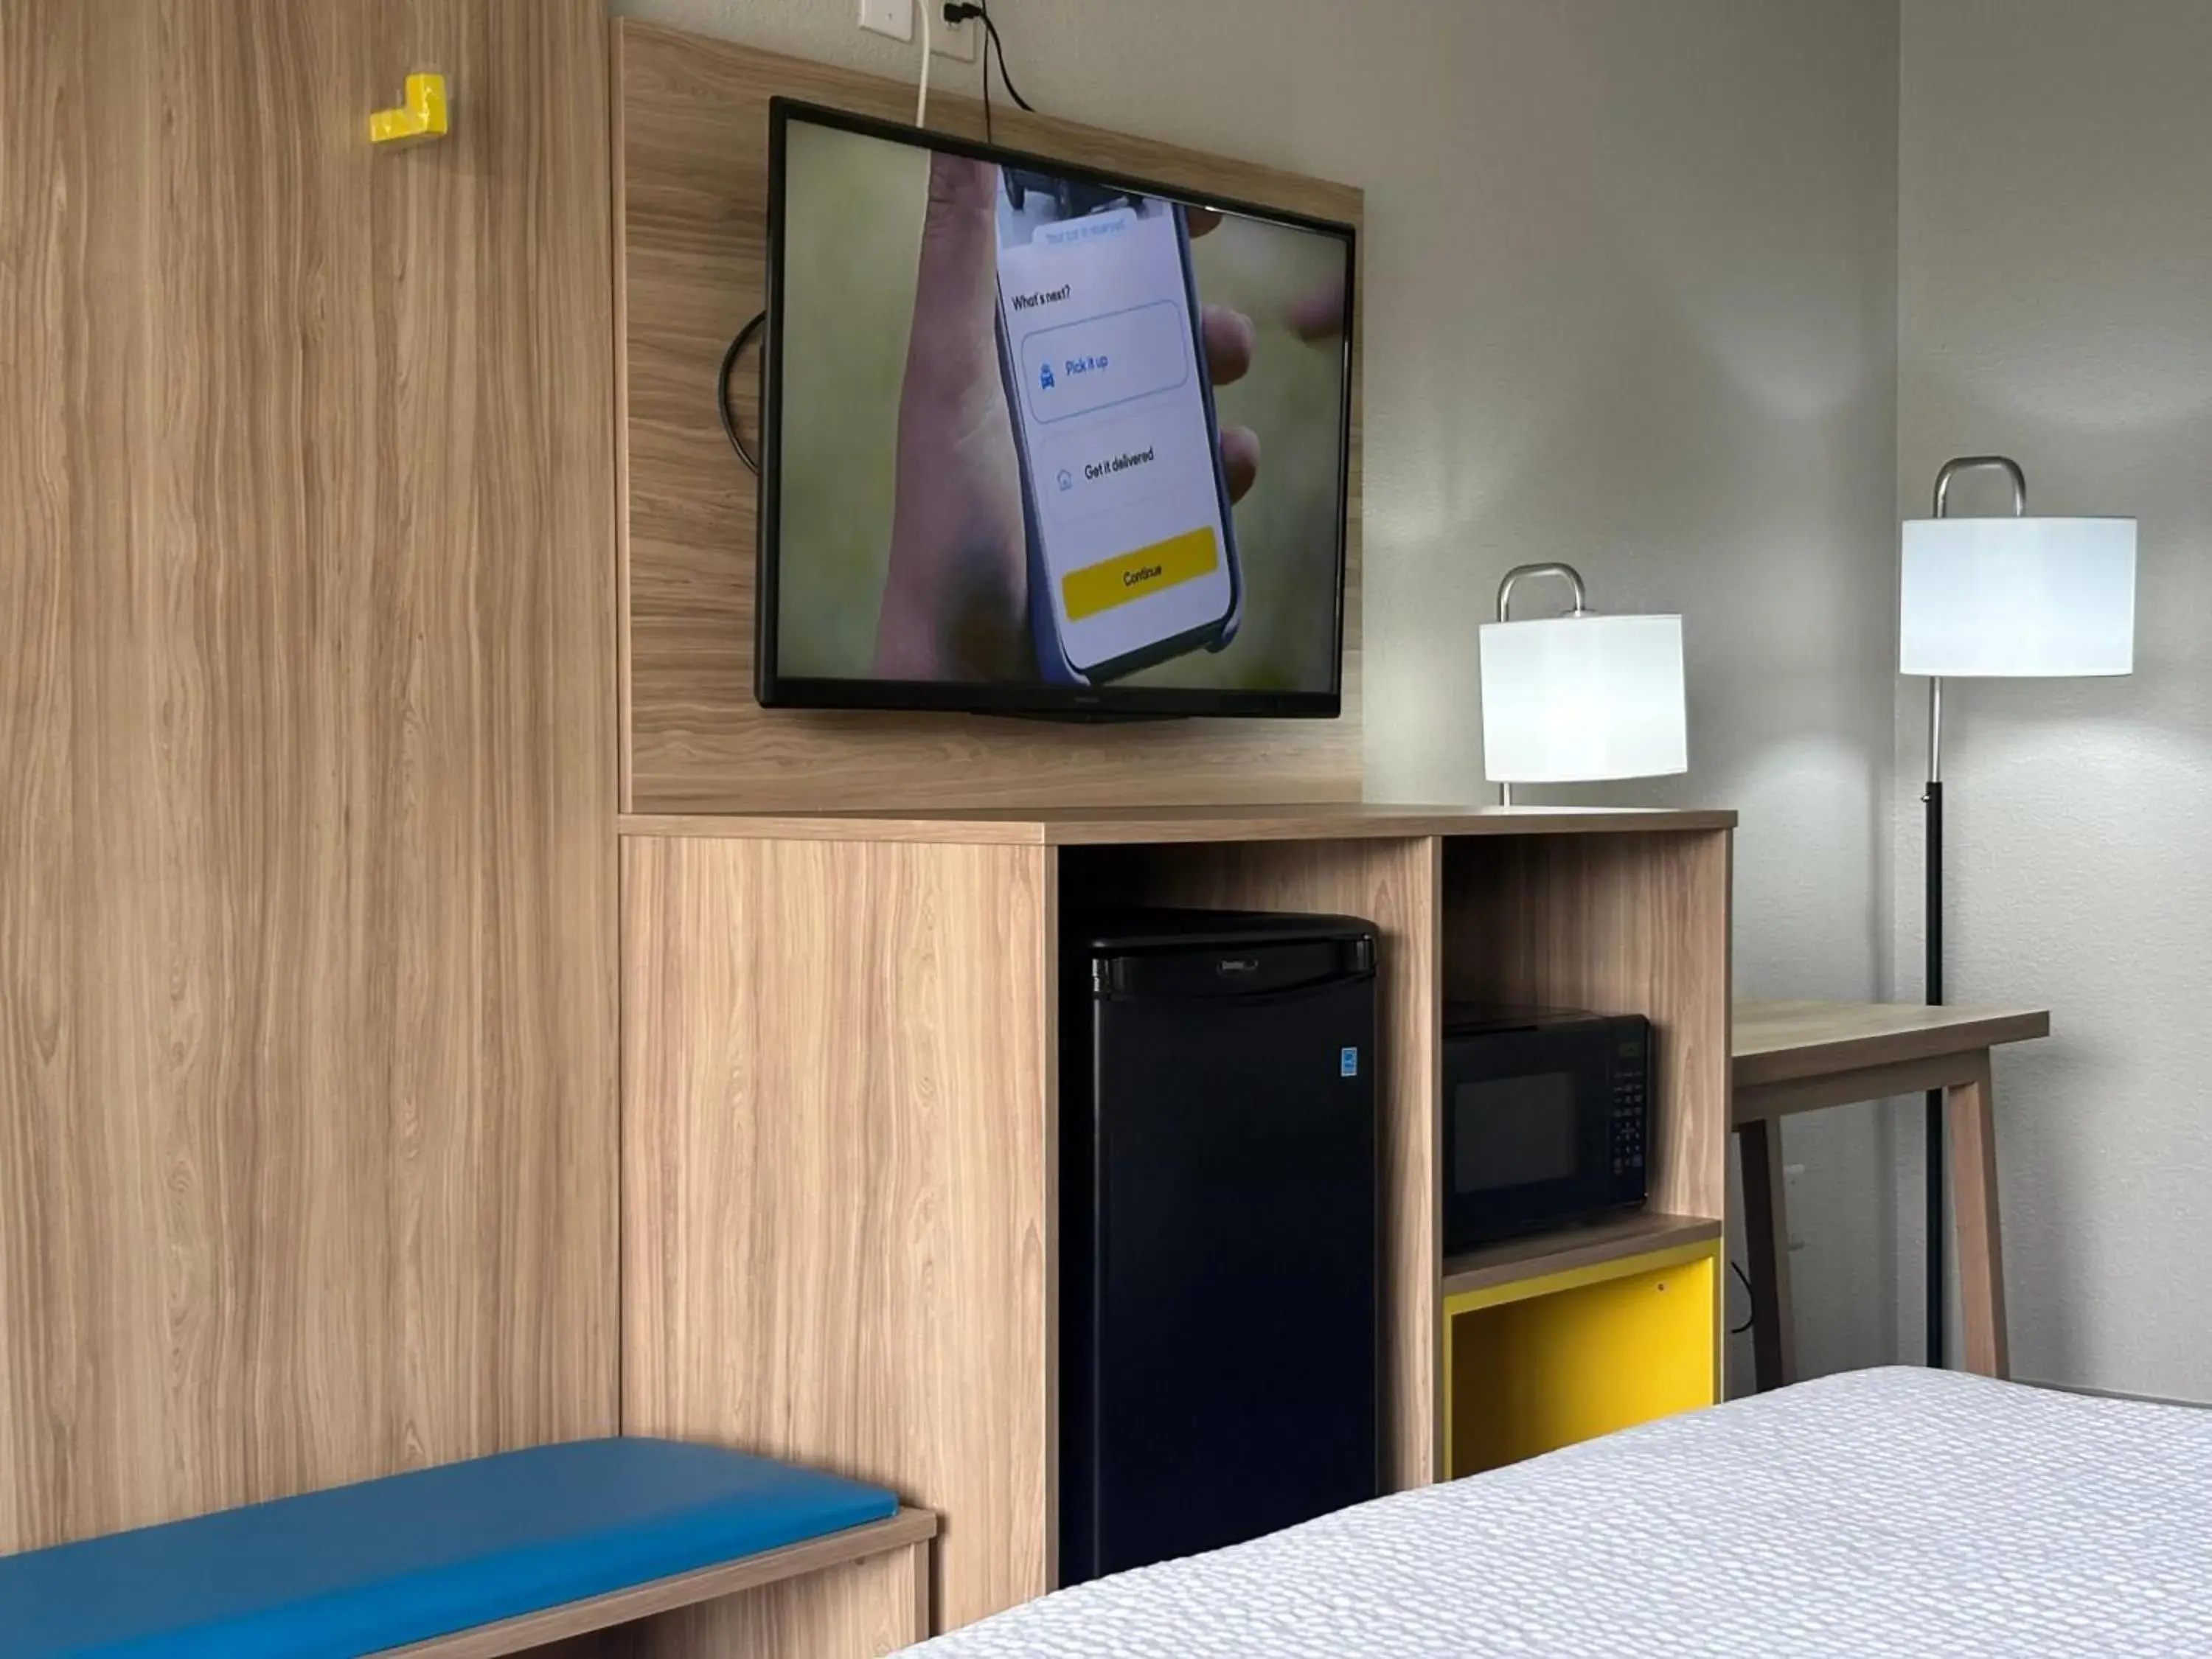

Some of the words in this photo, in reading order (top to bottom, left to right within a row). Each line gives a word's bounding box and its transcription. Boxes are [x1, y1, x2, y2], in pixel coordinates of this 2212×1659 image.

[1011, 291, 1045, 311] What's
[1046, 284, 1071, 304] next?
[1085, 462, 1103, 480] Get
[1103, 459, 1111, 474] it
[1112, 445, 1154, 472] delivered
[1123, 565, 1162, 588] Continue
